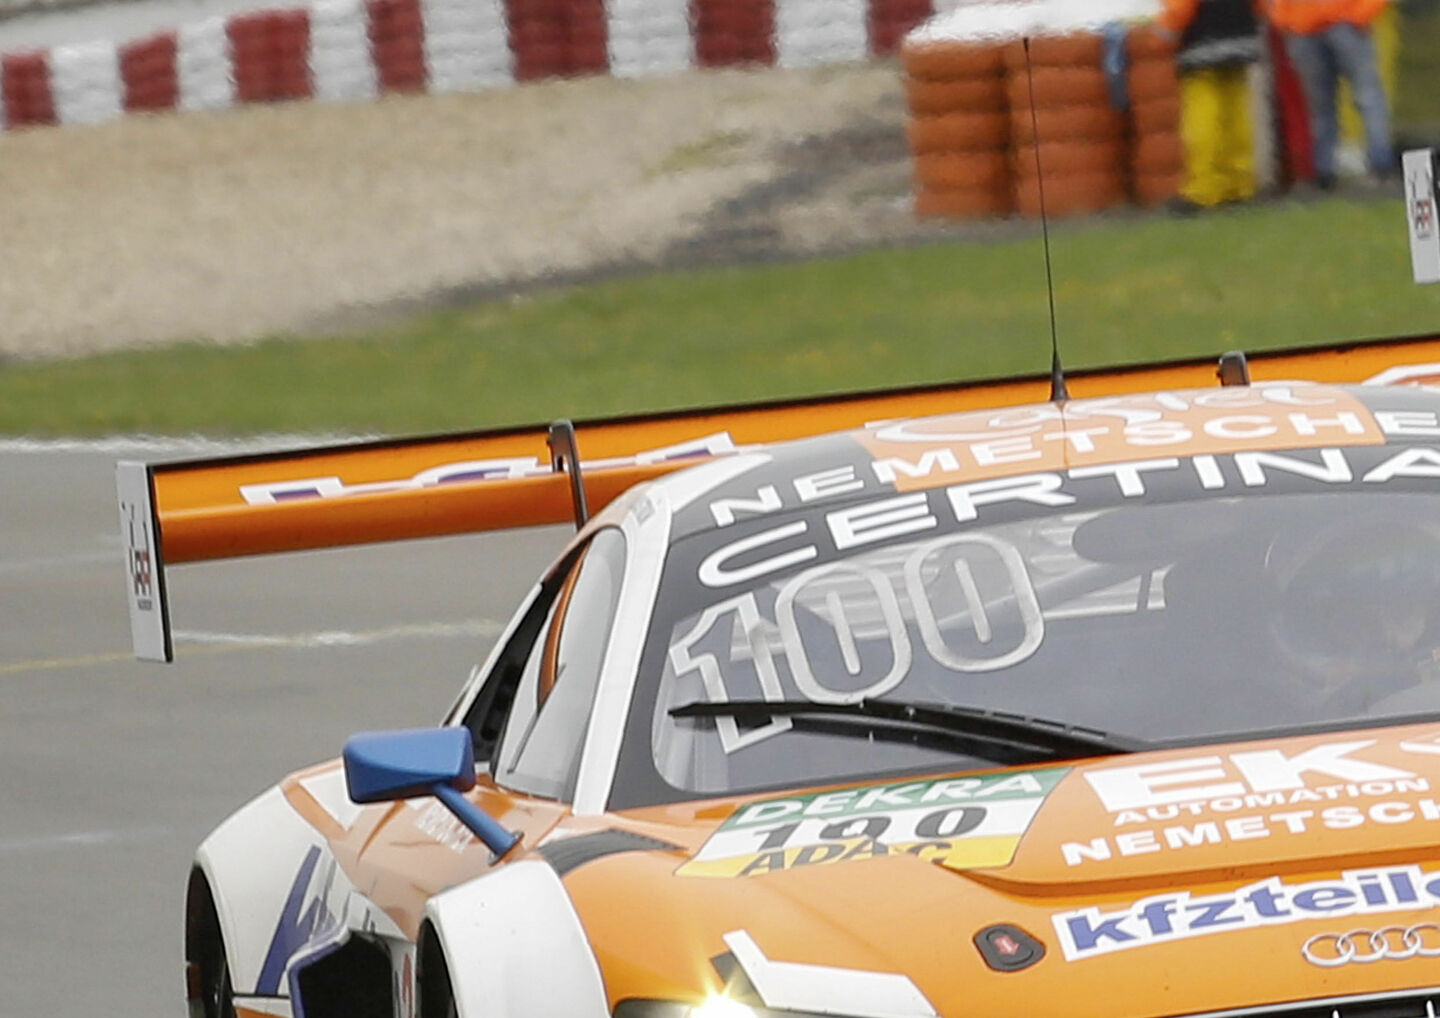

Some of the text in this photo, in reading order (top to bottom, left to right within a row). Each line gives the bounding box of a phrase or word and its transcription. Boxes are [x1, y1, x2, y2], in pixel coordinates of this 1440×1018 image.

[669, 533, 1045, 755] 100
[735, 772, 1044, 825] DEKRA
[1083, 739, 1418, 812] EK
[1113, 777, 1430, 826] AUTOMATION
